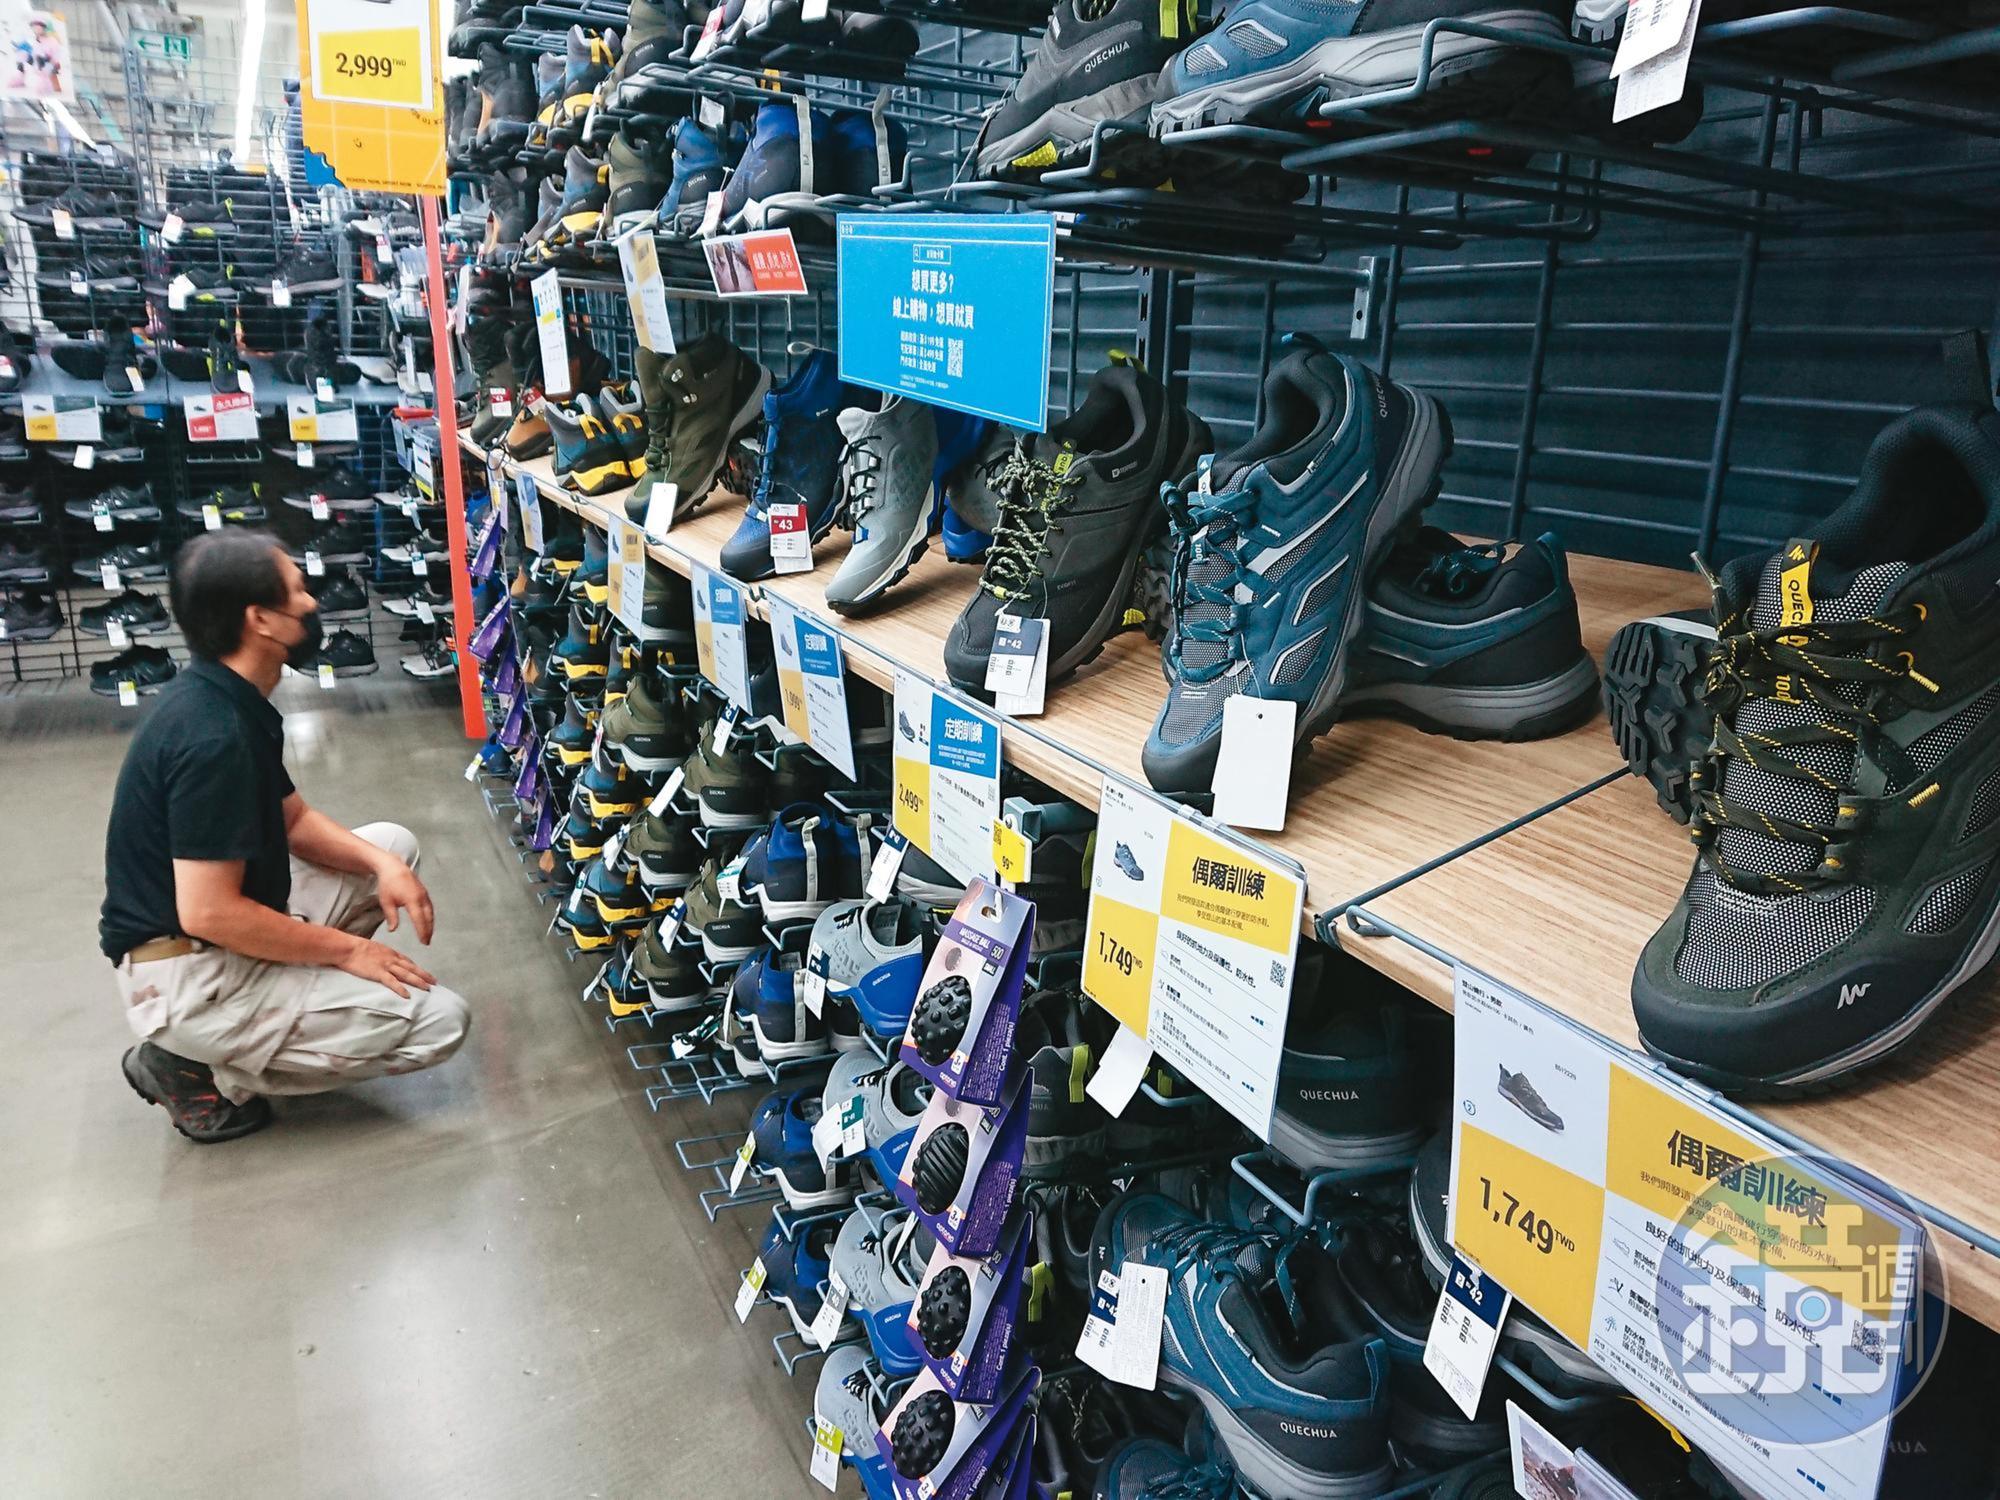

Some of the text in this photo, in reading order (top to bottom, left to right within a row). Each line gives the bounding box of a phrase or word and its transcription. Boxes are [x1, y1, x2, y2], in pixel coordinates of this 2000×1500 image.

[335, 52, 392, 78] 2,999
[1084, 41, 1130, 73] QUECHUA
[778, 519, 793, 530] 43
[1011, 639, 1023, 650] 42
[944, 718, 983, 744] 定期訓練
[899, 783, 919, 813] 2,499
[1002, 855, 1009, 870] 99
[1192, 856, 1266, 901] 偶爾訓練
[959, 927, 1005, 960] MASSAGE BALL 500
[1099, 931, 1143, 976] 1,749 TWD
[1299, 1089, 1360, 1101] QUECHUA
[1667, 1129, 1828, 1229] 偶爾訓練
[1480, 1176, 1554, 1254] 1,749
[1554, 1229, 1576, 1252] TWD
[1469, 1286, 1483, 1306] 42
[1645, 1220, 1821, 1348] 良好的抓地力及保護性。 防水性。
[1279, 1421, 1338, 1439] QUECHUA
